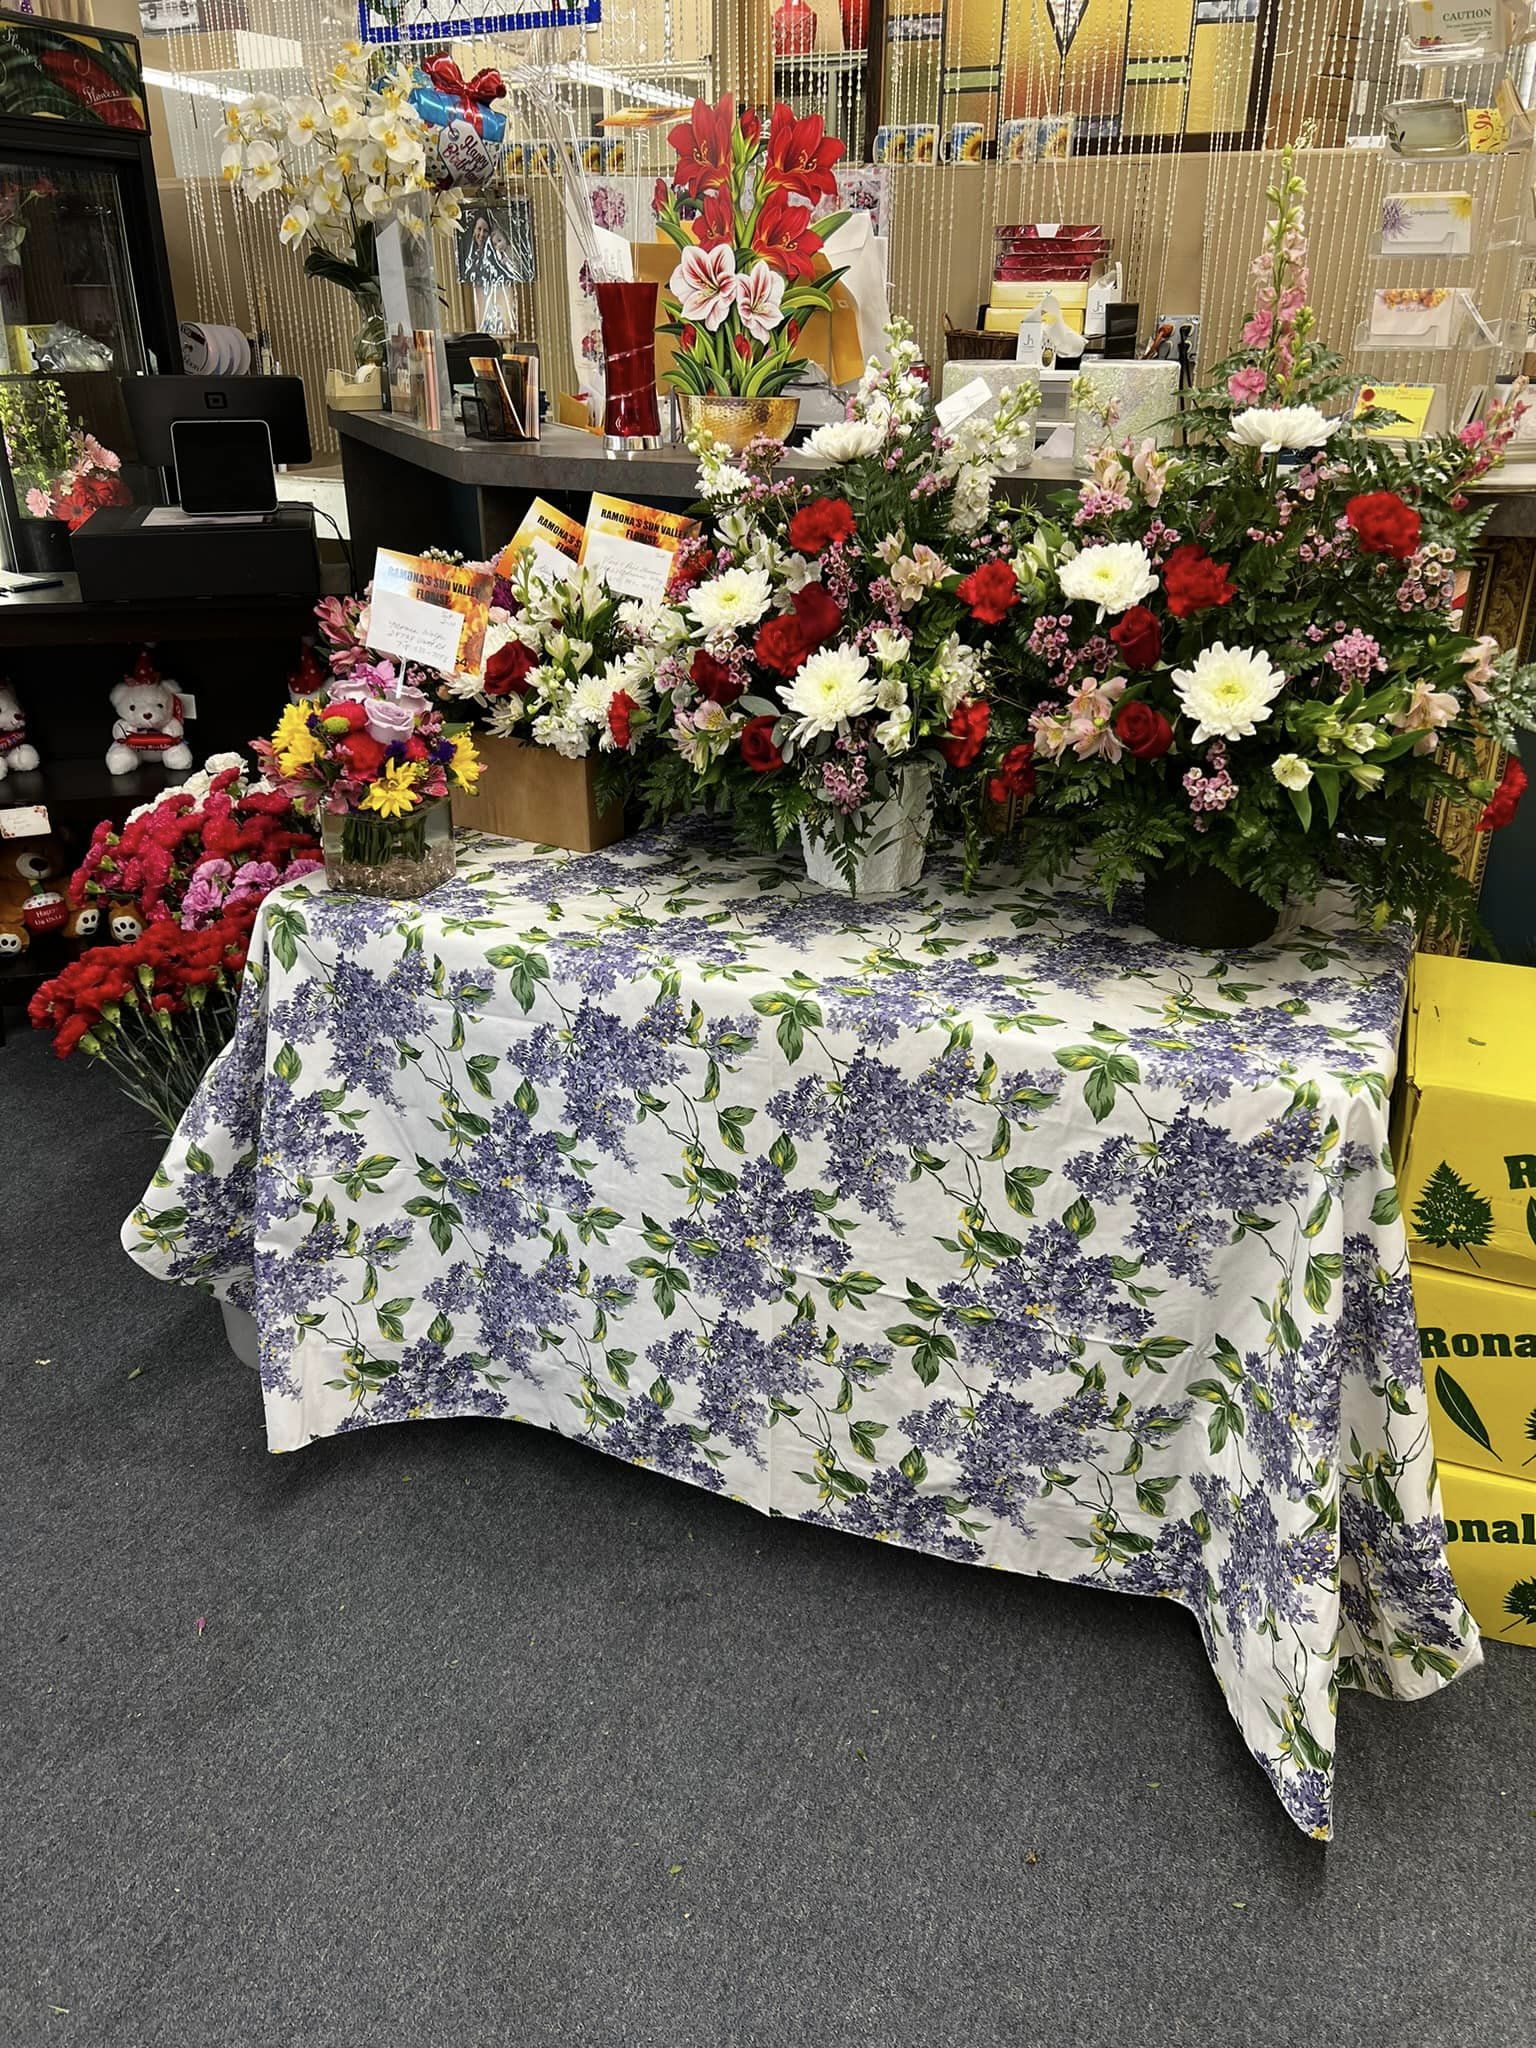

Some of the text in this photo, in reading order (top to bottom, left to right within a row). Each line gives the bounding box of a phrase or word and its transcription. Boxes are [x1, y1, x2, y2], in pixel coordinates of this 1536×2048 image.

[1442, 8, 1492, 21] CAUTION
[82, 86, 121, 104] Flowers
[460, 135, 489, 172] Happy
[537, 515, 576, 545] RAMONA'S
[600, 508, 643, 528] RAMONA'S
[643, 521, 660, 533] SUN
[626, 529, 657, 545] FLORIST
[387, 566, 432, 586] RAMONA'S
[433, 577, 451, 591] SUN
